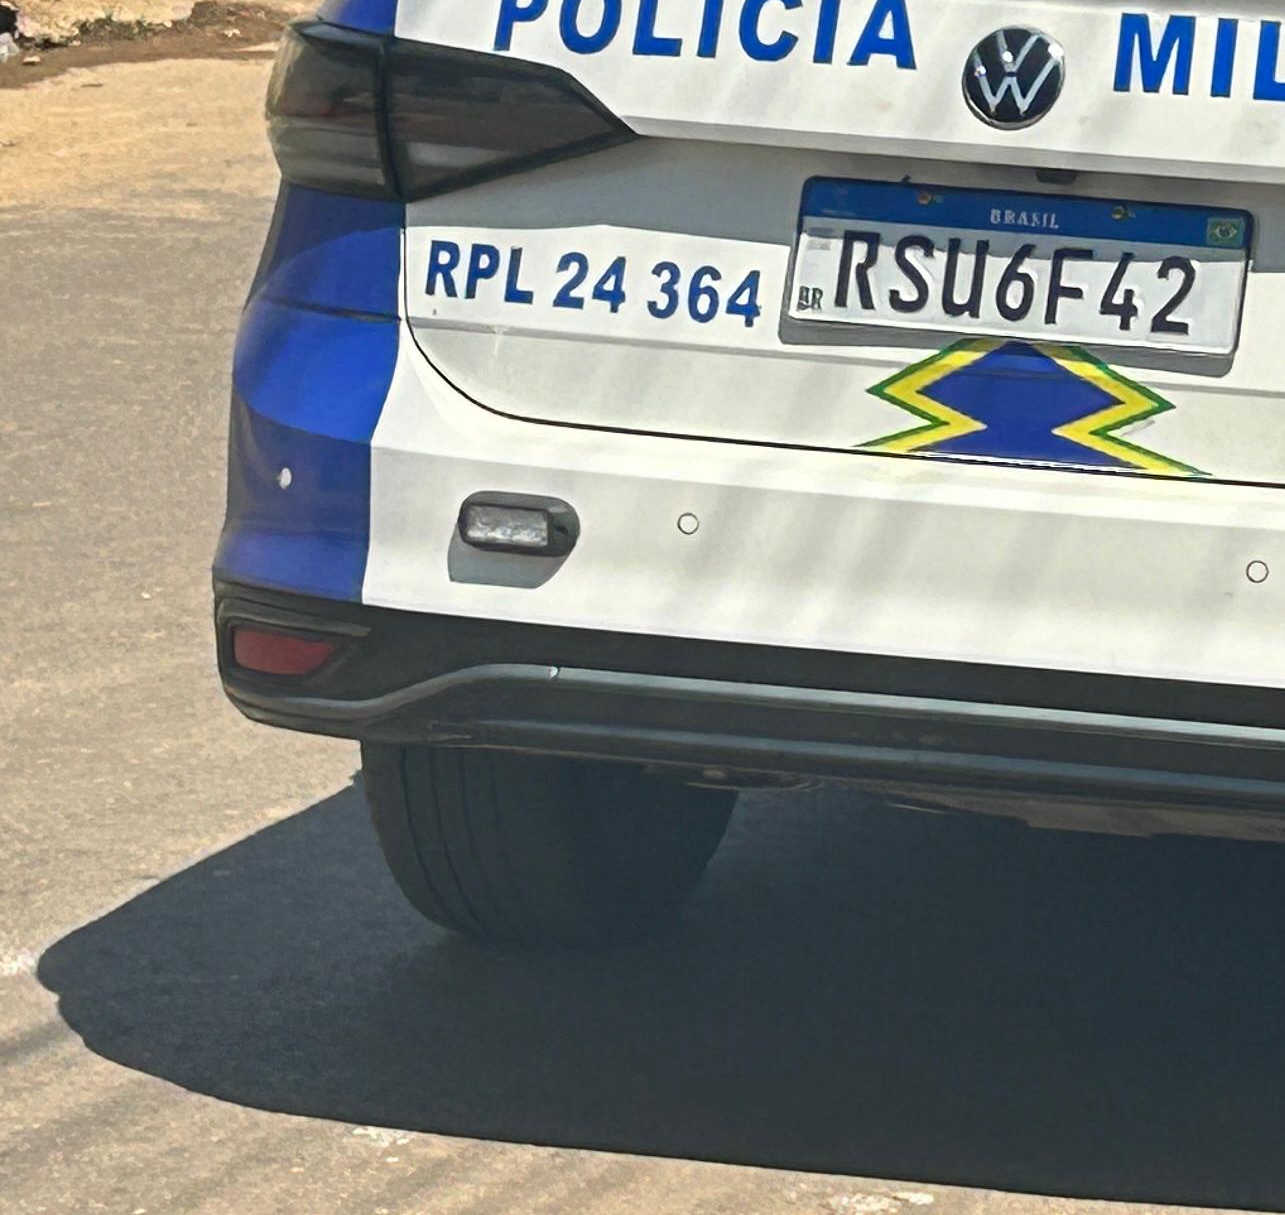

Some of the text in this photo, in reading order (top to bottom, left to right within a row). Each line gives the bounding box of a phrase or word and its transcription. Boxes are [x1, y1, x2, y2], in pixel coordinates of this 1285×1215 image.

[424, 239, 762, 328] RPL 24 364
[834, 229, 1197, 336] RSU6F42
